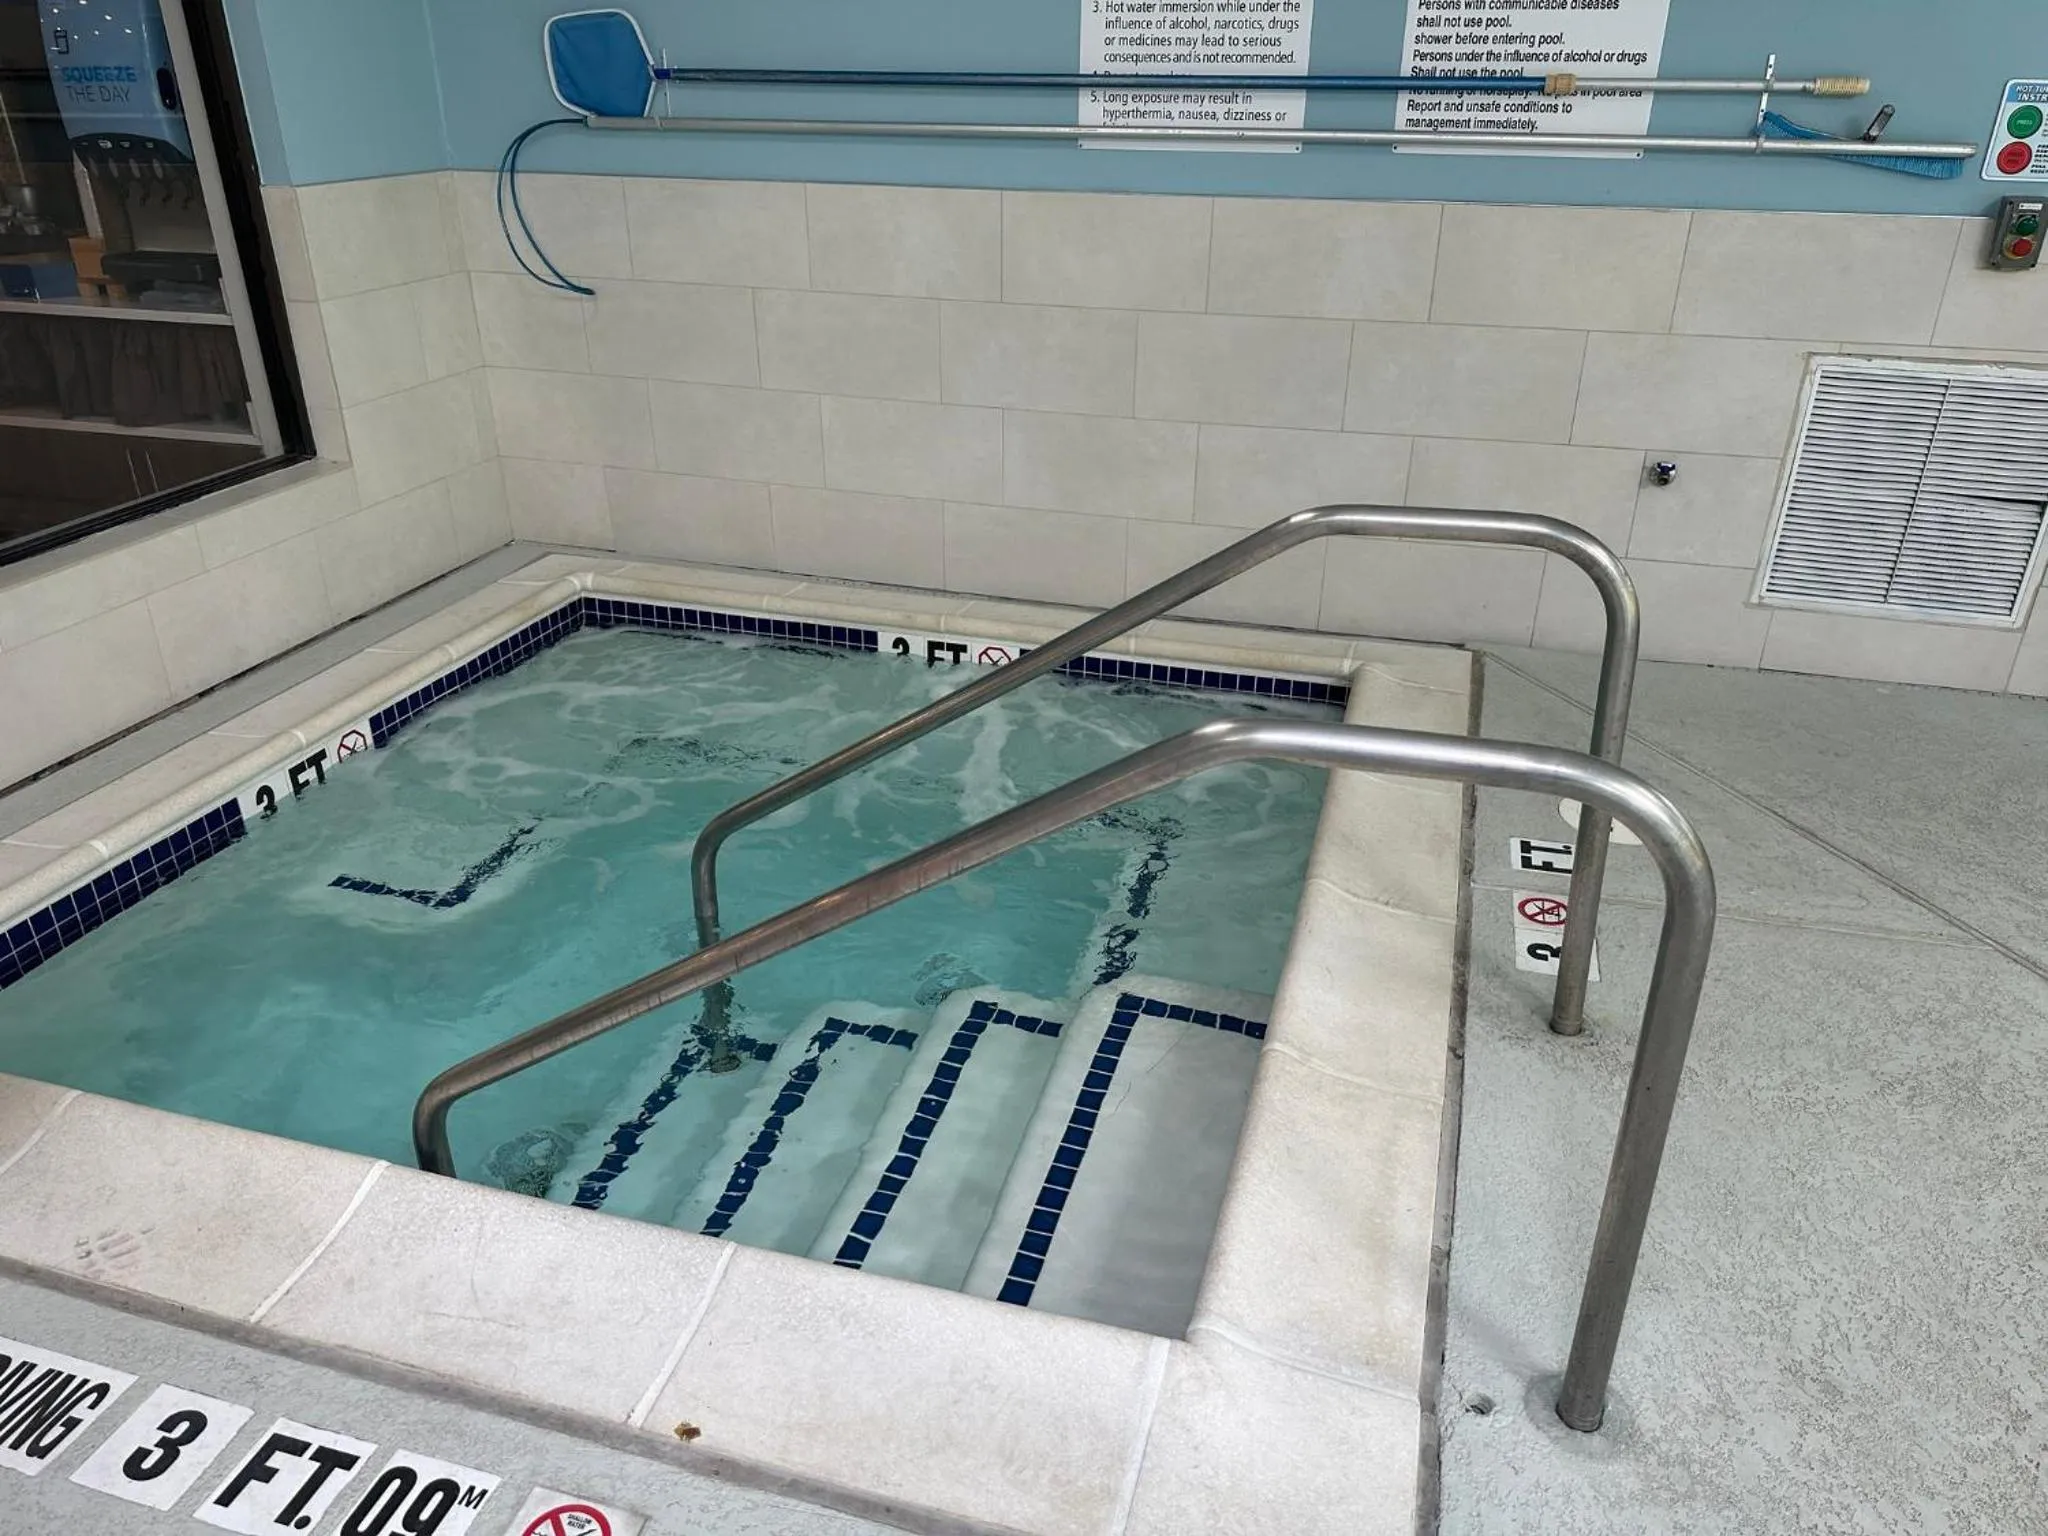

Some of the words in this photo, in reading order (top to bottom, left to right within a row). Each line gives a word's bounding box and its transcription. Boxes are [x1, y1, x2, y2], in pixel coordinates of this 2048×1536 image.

[1092, 1, 1102, 13] 3.
[1105, 1, 1124, 13] Hot
[1126, 2, 1156, 13] water
[1158, 1, 1214, 13] immersion
[1216, 1, 1246, 13] while
[1249, 1, 1280, 13] under
[1282, 1, 1301, 13] the
[1418, 0, 1461, 10] Persons
[1464, 0, 1486, 10] with
[1488, 0, 1568, 10] communicable
[1570, 0, 1619, 10] diseases
[1104, 17, 1155, 29] influence
[1156, 17, 1167, 30] of
[1169, 18, 1210, 31] alcohol,
[1213, 19, 1265, 31] narcotics,
[1268, 19, 1299, 33] drugs
[1416, 15, 1441, 27] shall
[1444, 16, 1461, 27] not
[1463, 18, 1483, 27] use
[1485, 15, 1512, 30] pool.
[1104, 37, 1115, 46] or
[1118, 34, 1172, 47] medicines
[1175, 37, 1198, 49] may
[1201, 35, 1224, 47] lead
[1227, 36, 1239, 47] to
[1242, 36, 1282, 47] serious
[1414, 32, 1451, 45] shower
[1455, 32, 1489, 45] before
[1491, 33, 1536, 48] entering
[1538, 32, 1565, 48] pool.
[1104, 52, 1171, 66] consequences
[1172, 51, 1191, 63] and
[1193, 51, 1201, 63] is
[1202, 53, 1219, 63] not
[1220, 51, 1296, 64] recommended.
[1412, 50, 1453, 62] Persons
[1454, 49, 1484, 62] under
[1486, 50, 1501, 62] the
[1503, 49, 1550, 62] influence
[1551, 50, 1563, 63] of
[1563, 50, 1602, 63] alcohol
[1603, 53, 1615, 63] or
[1617, 52, 1648, 66] drugs
[61, 66, 137, 82] SQUEEZE
[1411, 66, 1437, 77] Shall
[1440, 68, 1457, 77] not
[1459, 69, 1478, 77] use
[1480, 67, 1497, 77] the
[65, 86, 96, 103] THE
[99, 86, 130, 102] DAY
[1090, 91, 1100, 102] 5.
[1103, 91, 1129, 106] Long
[1131, 93, 1179, 106] exposure
[1182, 94, 1205, 107] may
[1208, 92, 1239, 105] result
[1242, 93, 1252, 105] in
[1102, 106, 1175, 122] hyperthermia,
[1178, 109, 1220, 122] nausea,
[1223, 107, 1272, 121] dizziness
[1274, 111, 1287, 121] or
[1407, 99, 1441, 114] Report
[1444, 100, 1463, 112] and
[1466, 100, 1501, 113] unsafe
[1503, 100, 1559, 113] conditions
[1561, 102, 1573, 113] to
[1405, 118, 1471, 131] management
[1473, 117, 1538, 131] immediately.
[927, 640, 968, 667] FT
[288, 748, 327, 799] FT
[1520, 839, 1573, 874] FT.
[0, 1353, 111, 1460] VING
[122, 1410, 208, 1481] 3
[213, 1433, 361, 1530] FT.
[567, 1520, 586, 1529] WATER
[568, 1514, 592, 1524] SHALLOW
